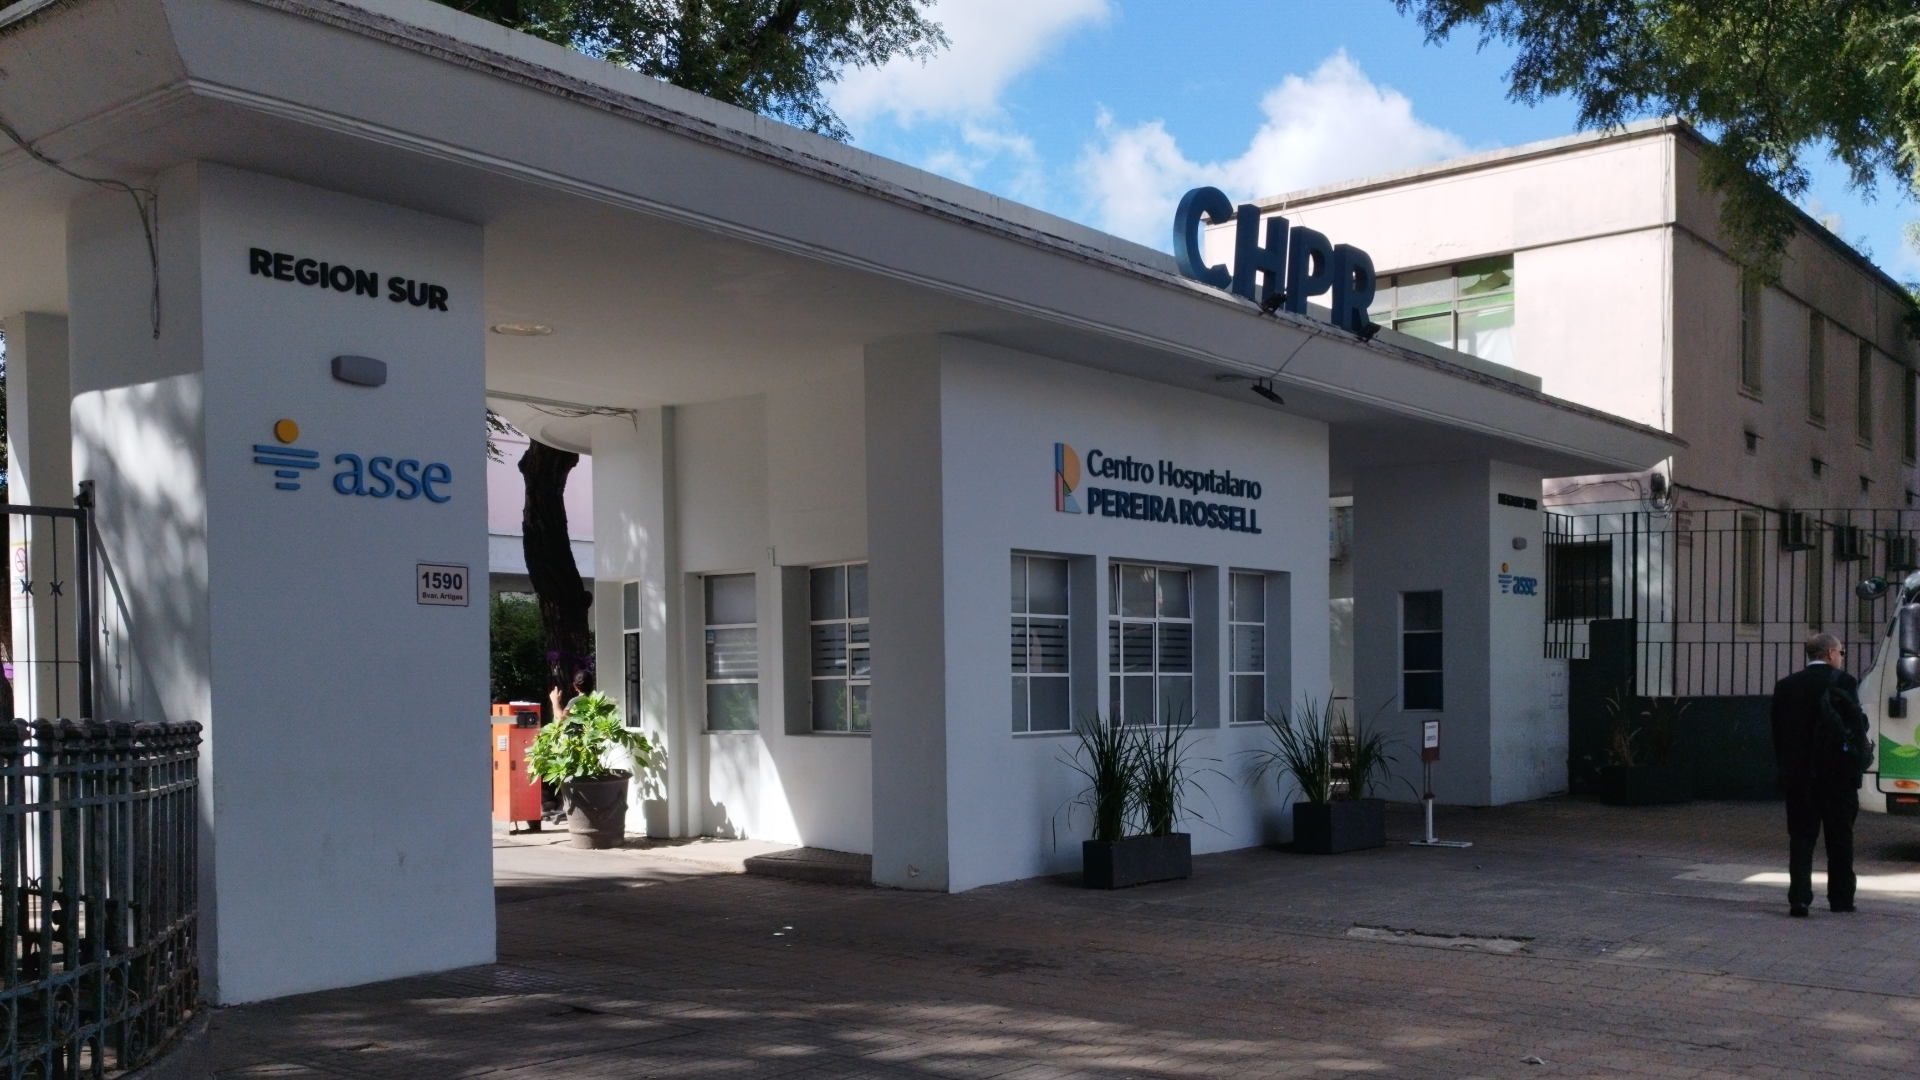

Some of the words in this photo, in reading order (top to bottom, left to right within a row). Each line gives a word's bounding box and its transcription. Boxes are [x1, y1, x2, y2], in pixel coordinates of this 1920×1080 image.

[250, 247, 378, 298] REGION
[388, 276, 448, 311] SUR
[1173, 186, 1376, 334] CHPR
[333, 453, 452, 503] asse
[1087, 449, 1154, 483] Centro
[1087, 487, 1178, 524] PEREIRA
[1179, 498, 1262, 534] ROSSELL
[422, 571, 463, 590] 1590
[440, 592, 463, 601] Artigas
[1512, 575, 1538, 596] asse
